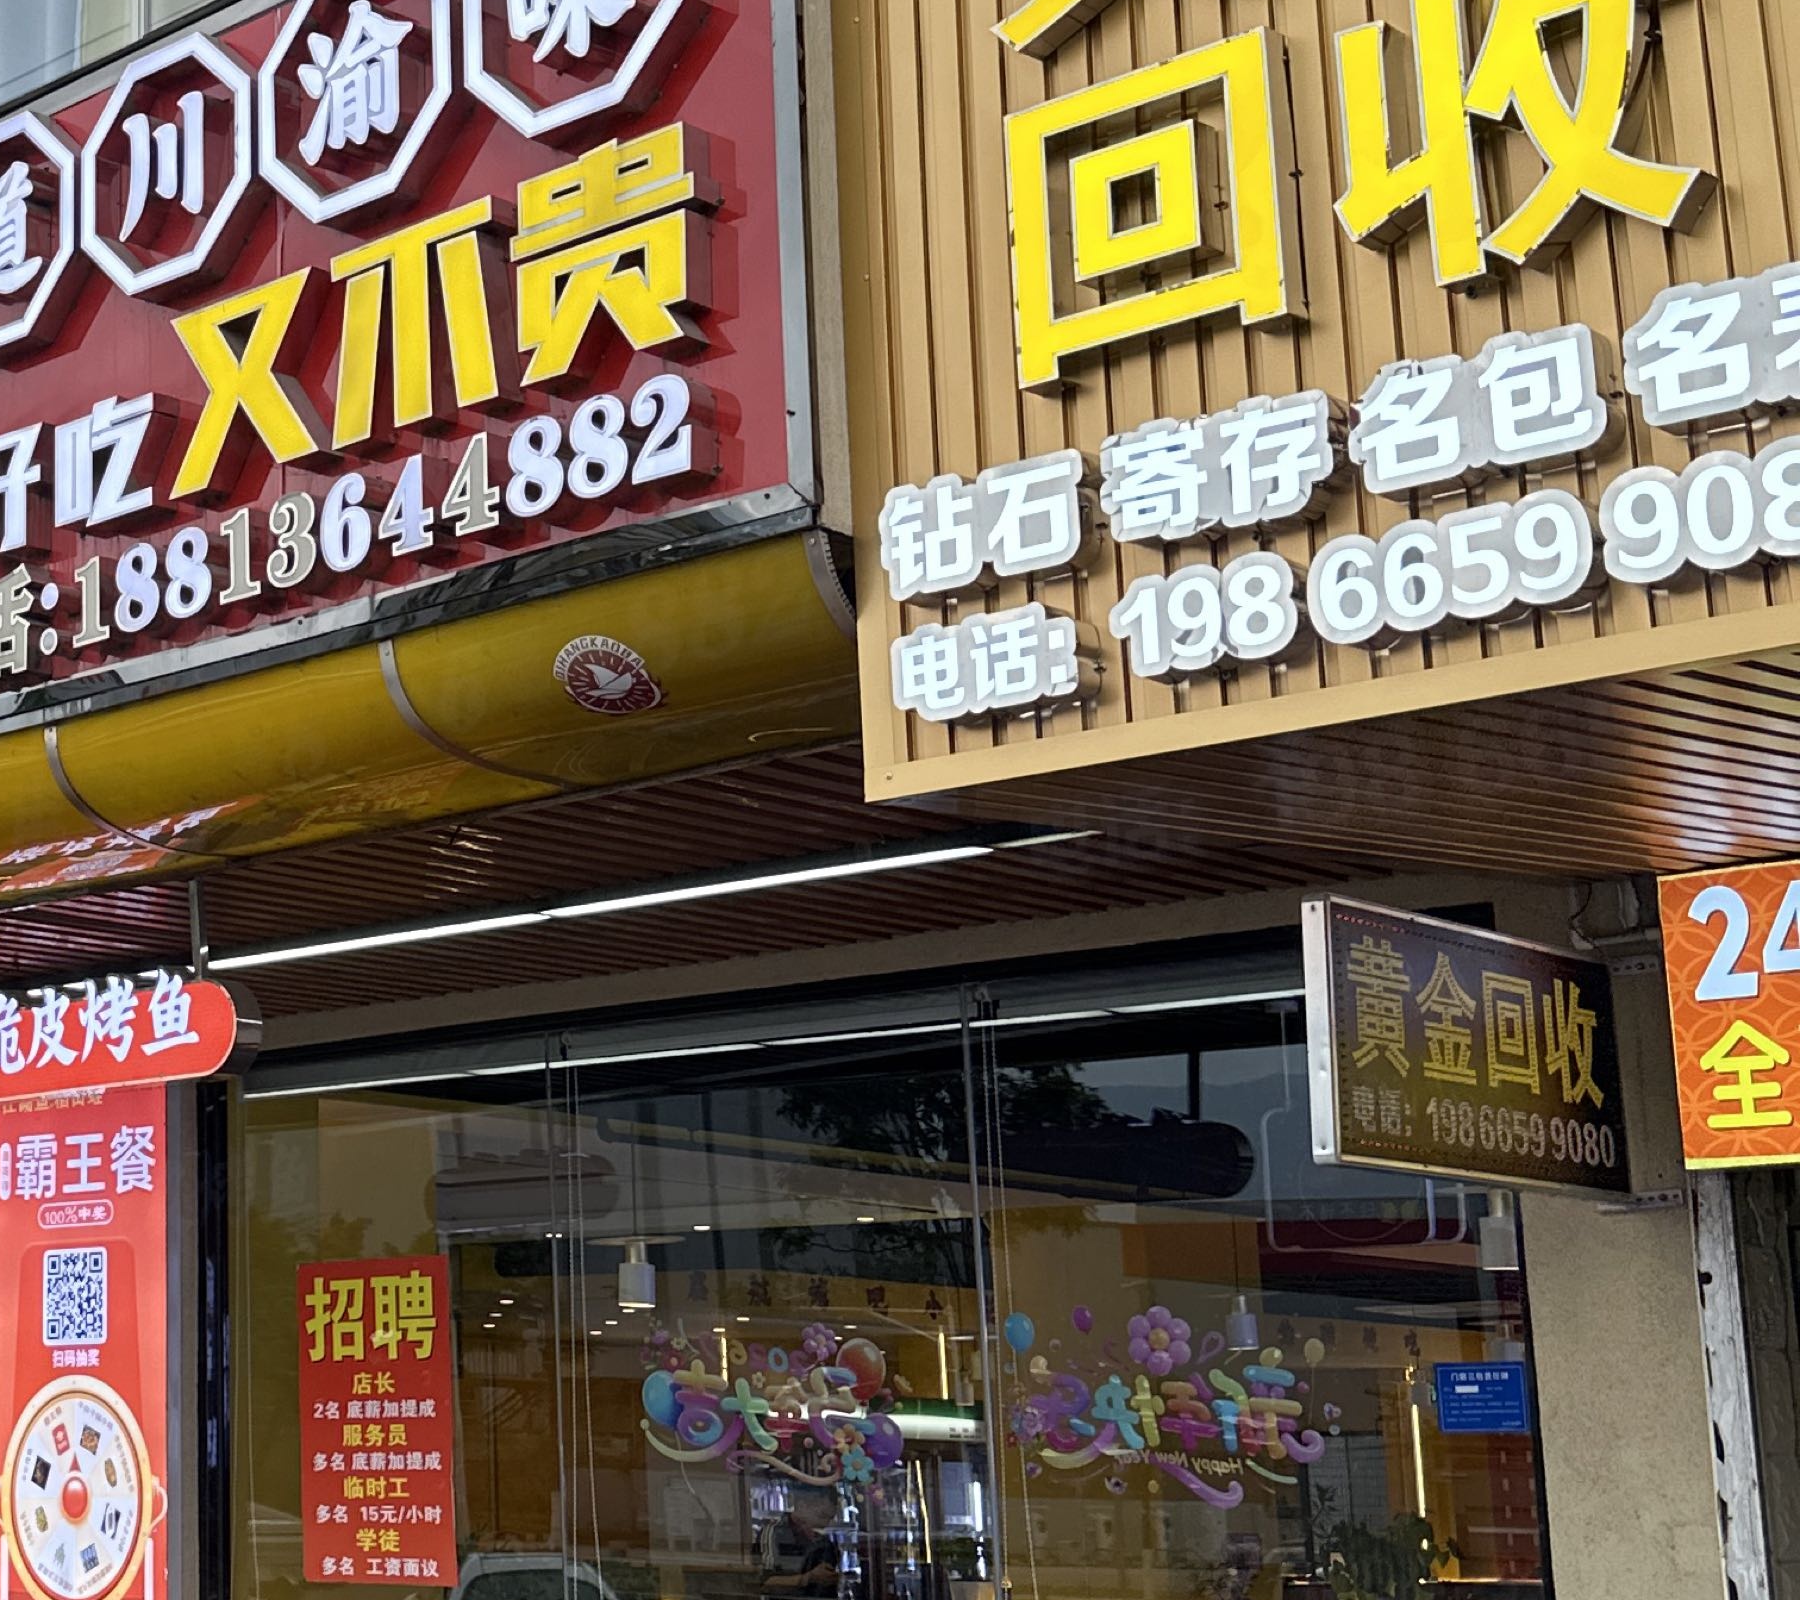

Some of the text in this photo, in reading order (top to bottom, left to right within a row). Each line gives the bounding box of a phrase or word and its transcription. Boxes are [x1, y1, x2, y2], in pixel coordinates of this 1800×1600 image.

[168, 121, 694, 500] 又不贵
[889, 275, 1800, 589] 钻石 寄存 名包 名
[901, 616, 1066, 708] 电话:
[1120, 565, 1285, 664] 198
[1320, 504, 1578, 631] 6659
[1347, 935, 1604, 1108] 黄金回收
[1699, 1019, 1790, 1129] 全
[15, 1124, 156, 1199] 霸王餐
[44, 1204, 107, 1225] 100%中奖
[305, 1270, 436, 1362] 招聘
[52, 1349, 100, 1369] 扫码抽奖
[352, 1372, 395, 1394] 店长
[313, 1399, 436, 1420] 2名 底薪加提成
[343, 1424, 407, 1447] 服务员
[312, 1451, 441, 1472] 多名 底薪加提成
[343, 1476, 410, 1499] 临时工
[316, 1504, 441, 1524] 多名 15元/小时
[356, 1528, 400, 1552] 学徒
[322, 1557, 439, 1577] 多名 工资面议
